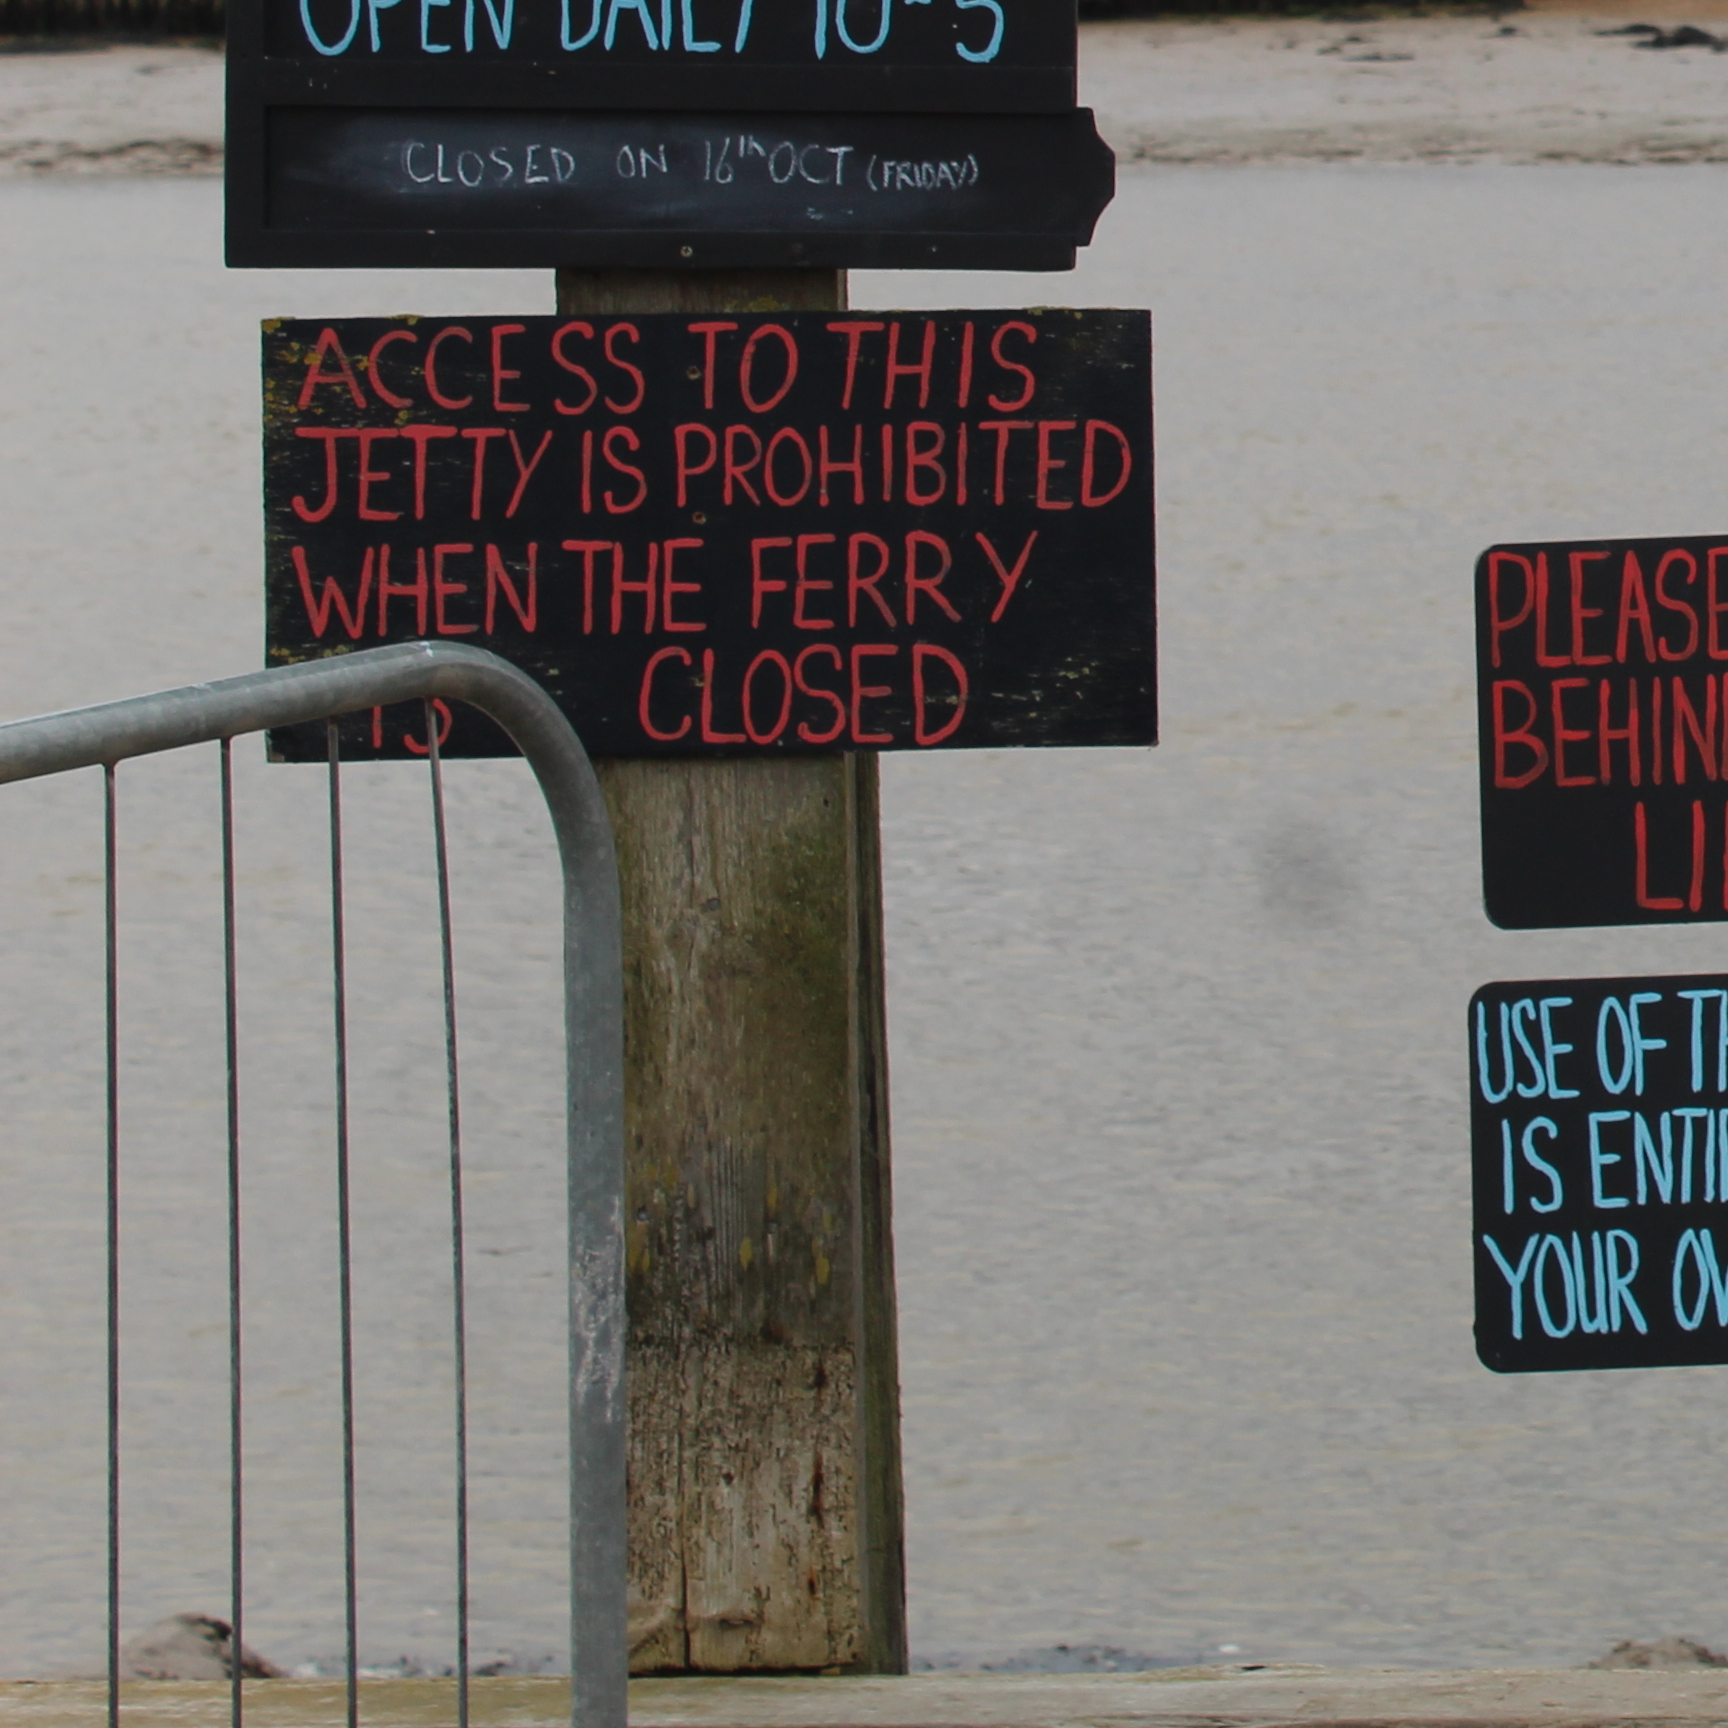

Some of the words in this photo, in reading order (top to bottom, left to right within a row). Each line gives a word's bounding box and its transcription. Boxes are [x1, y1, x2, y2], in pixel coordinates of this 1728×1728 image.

[407, 143, 575, 187] CLOSED
[616, 144, 668, 180] ON
[769, 142, 854, 185] OCT
[866, 153, 980, 192] (FRIDAY)
[297, 322, 646, 416] ACCESS
[687, 322, 799, 413] TO
[827, 320, 1037, 413] THIS
[292, 425, 553, 522] JETTY
[582, 425, 649, 515] IS
[674, 418, 1132, 512] PROHIBITED
[292, 542, 538, 639] WHEN
[561, 538, 706, 635] THE
[751, 530, 1038, 630] FERRY
[639, 643, 968, 746] CLOSED
[1477, 997, 1580, 1103] USE
[1596, 992, 1668, 1095] OF
[1501, 1116, 1563, 1215] IS
[1483, 1229, 1648, 1340] YOUR
